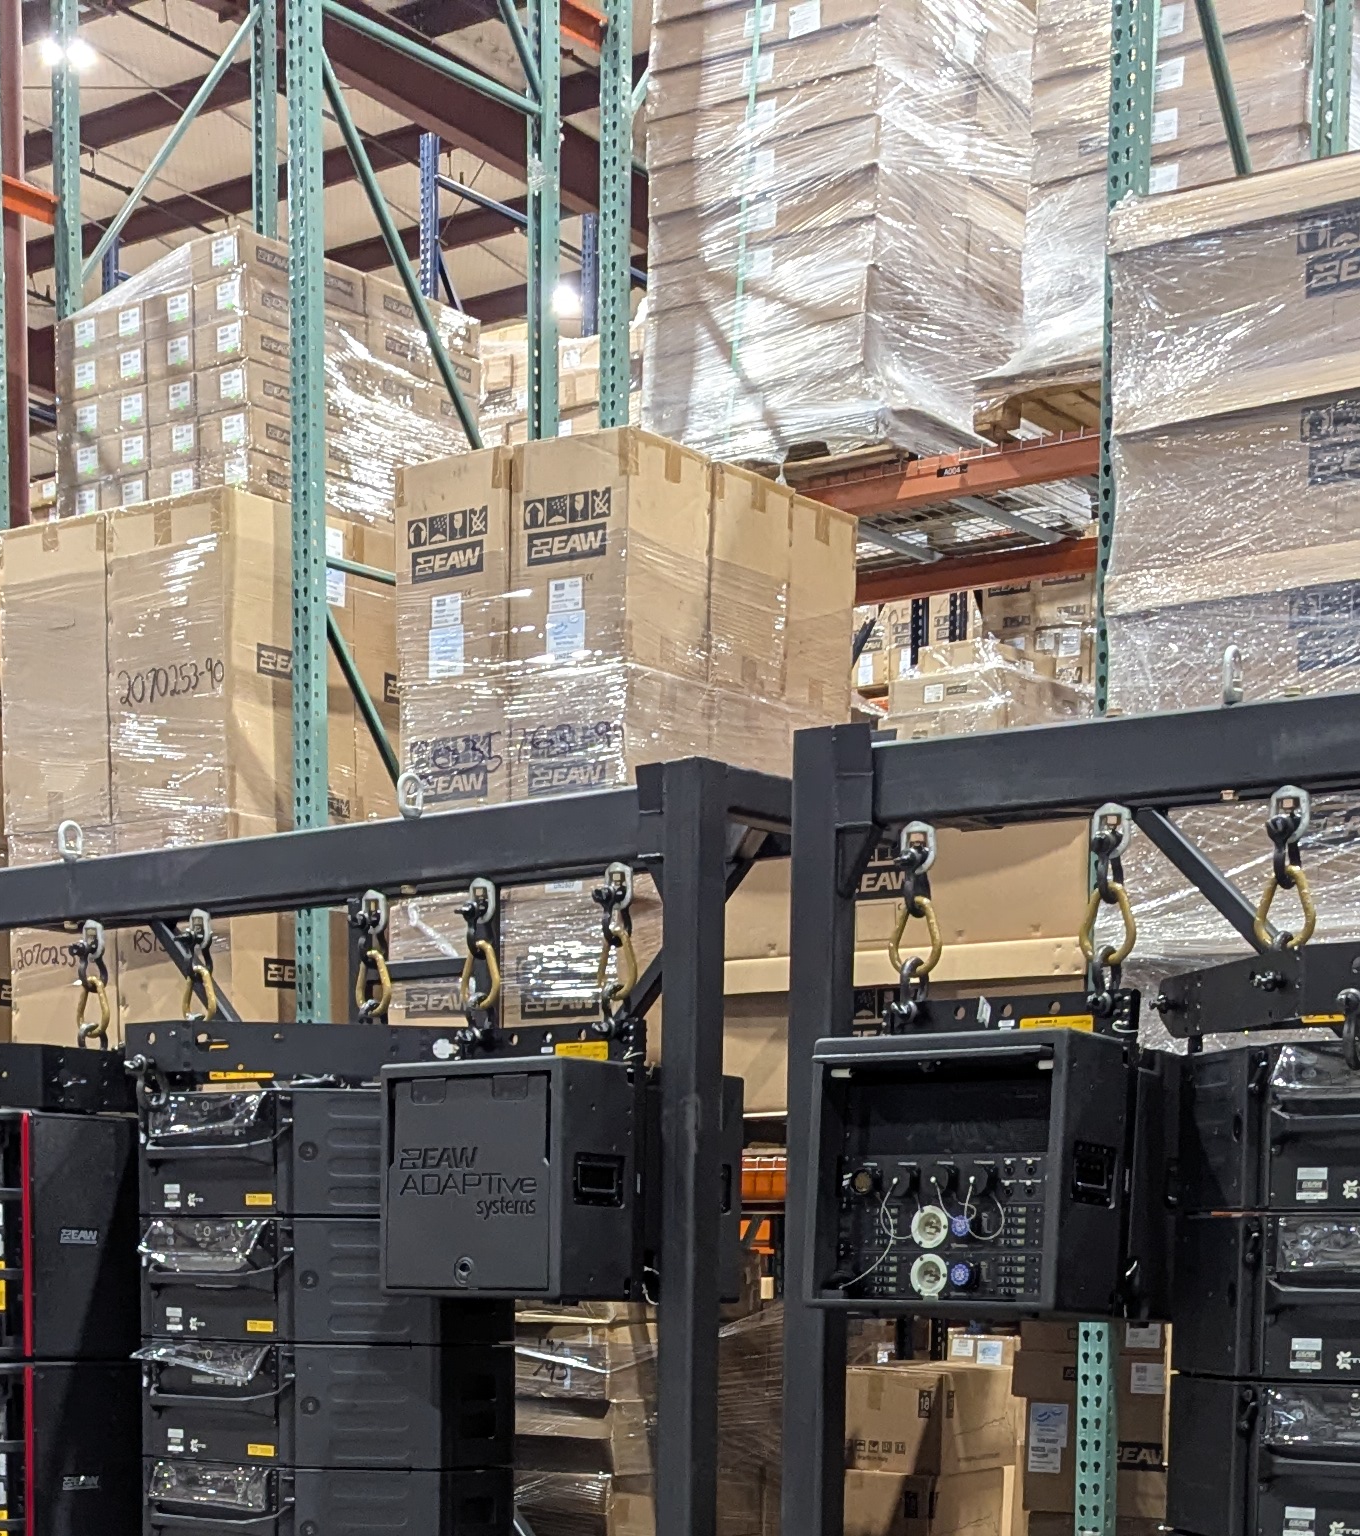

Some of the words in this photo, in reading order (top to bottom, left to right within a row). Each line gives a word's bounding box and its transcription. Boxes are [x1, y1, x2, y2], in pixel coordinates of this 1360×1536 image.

[943, 466, 961, 476] A004
[551, 530, 605, 553] EAW
[434, 547, 481, 572] EAW
[120, 657, 225, 707] 2070253-90
[437, 772, 485, 795] EAW
[552, 762, 606, 786] EAW
[421, 1147, 477, 1169] EAW
[399, 1172, 538, 1196] ADAPTive
[476, 1198, 537, 1220] systems
[71, 1229, 98, 1241] EAW
